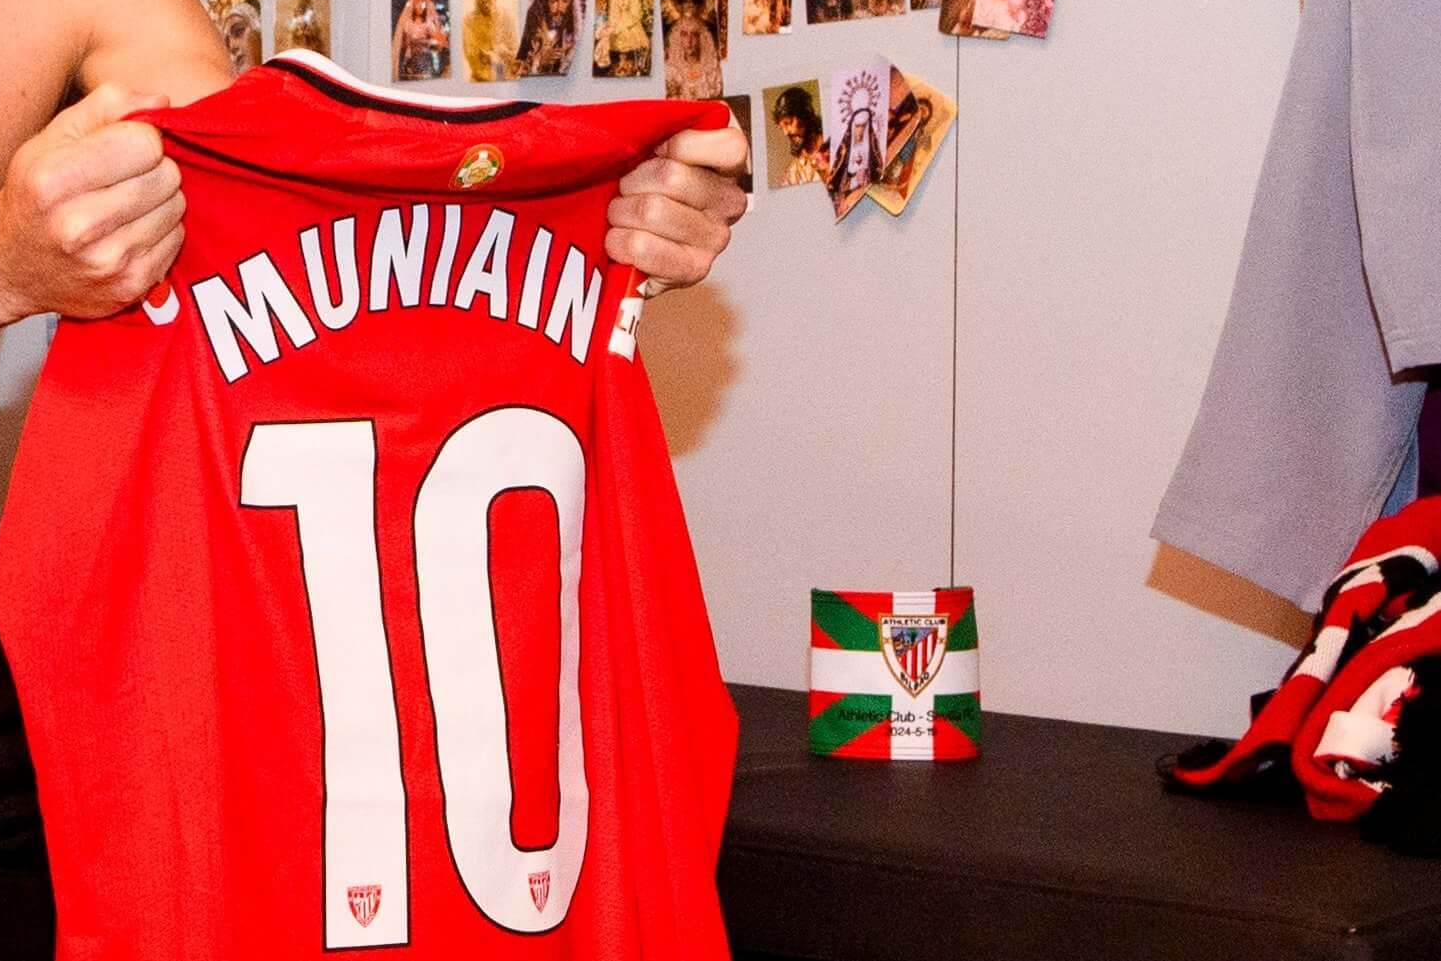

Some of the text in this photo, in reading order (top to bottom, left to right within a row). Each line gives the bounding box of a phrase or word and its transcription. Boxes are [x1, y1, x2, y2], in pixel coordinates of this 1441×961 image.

[191, 203, 604, 385] MUNIAIN
[238, 404, 590, 952] 10
[889, 709, 916, 723] Club
